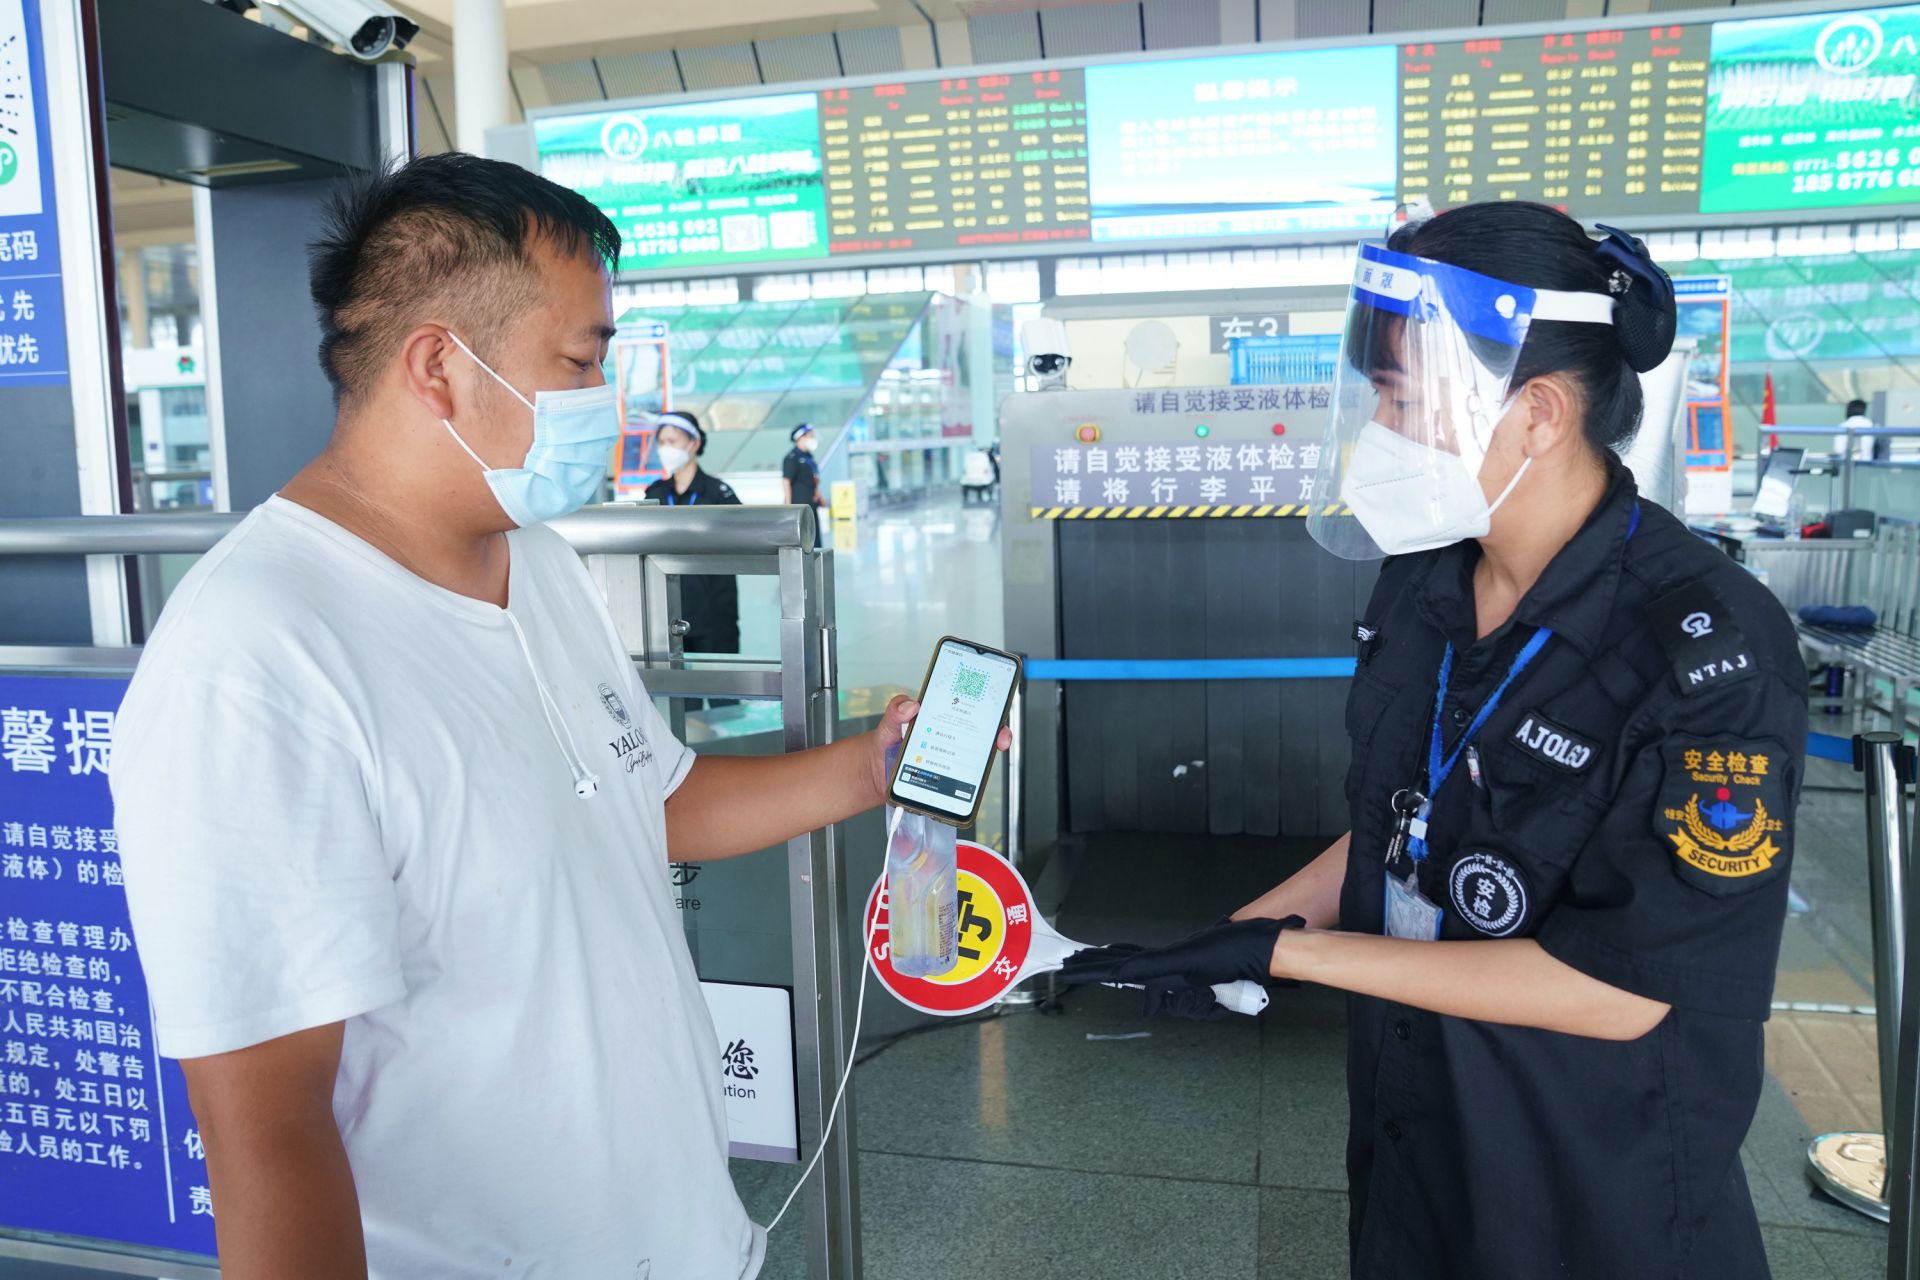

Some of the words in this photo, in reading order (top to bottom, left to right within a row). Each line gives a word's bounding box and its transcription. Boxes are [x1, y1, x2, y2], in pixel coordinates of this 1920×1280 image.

[1135, 386, 1359, 414] 请自觉接受液体检
[1054, 443, 1321, 474] 请自觉接受液体检查
[1688, 654, 1749, 685] NTAJ
[1684, 749, 1769, 775] 安全检查
[1691, 771, 1728, 785] Security
[1733, 774, 1761, 786] Check
[3, 821, 119, 854] 请自觉接受
[1688, 849, 1761, 873] SECURITY
[1473, 878, 1496, 919] 安检
[0, 916, 132, 952] 检查管理办
[3, 1010, 142, 1050] 人民共和国治
[0, 1039, 145, 1081] 规定，处警告
[722, 1038, 759, 1080] 您
[0, 1101, 151, 1143] 五百元以下罚
